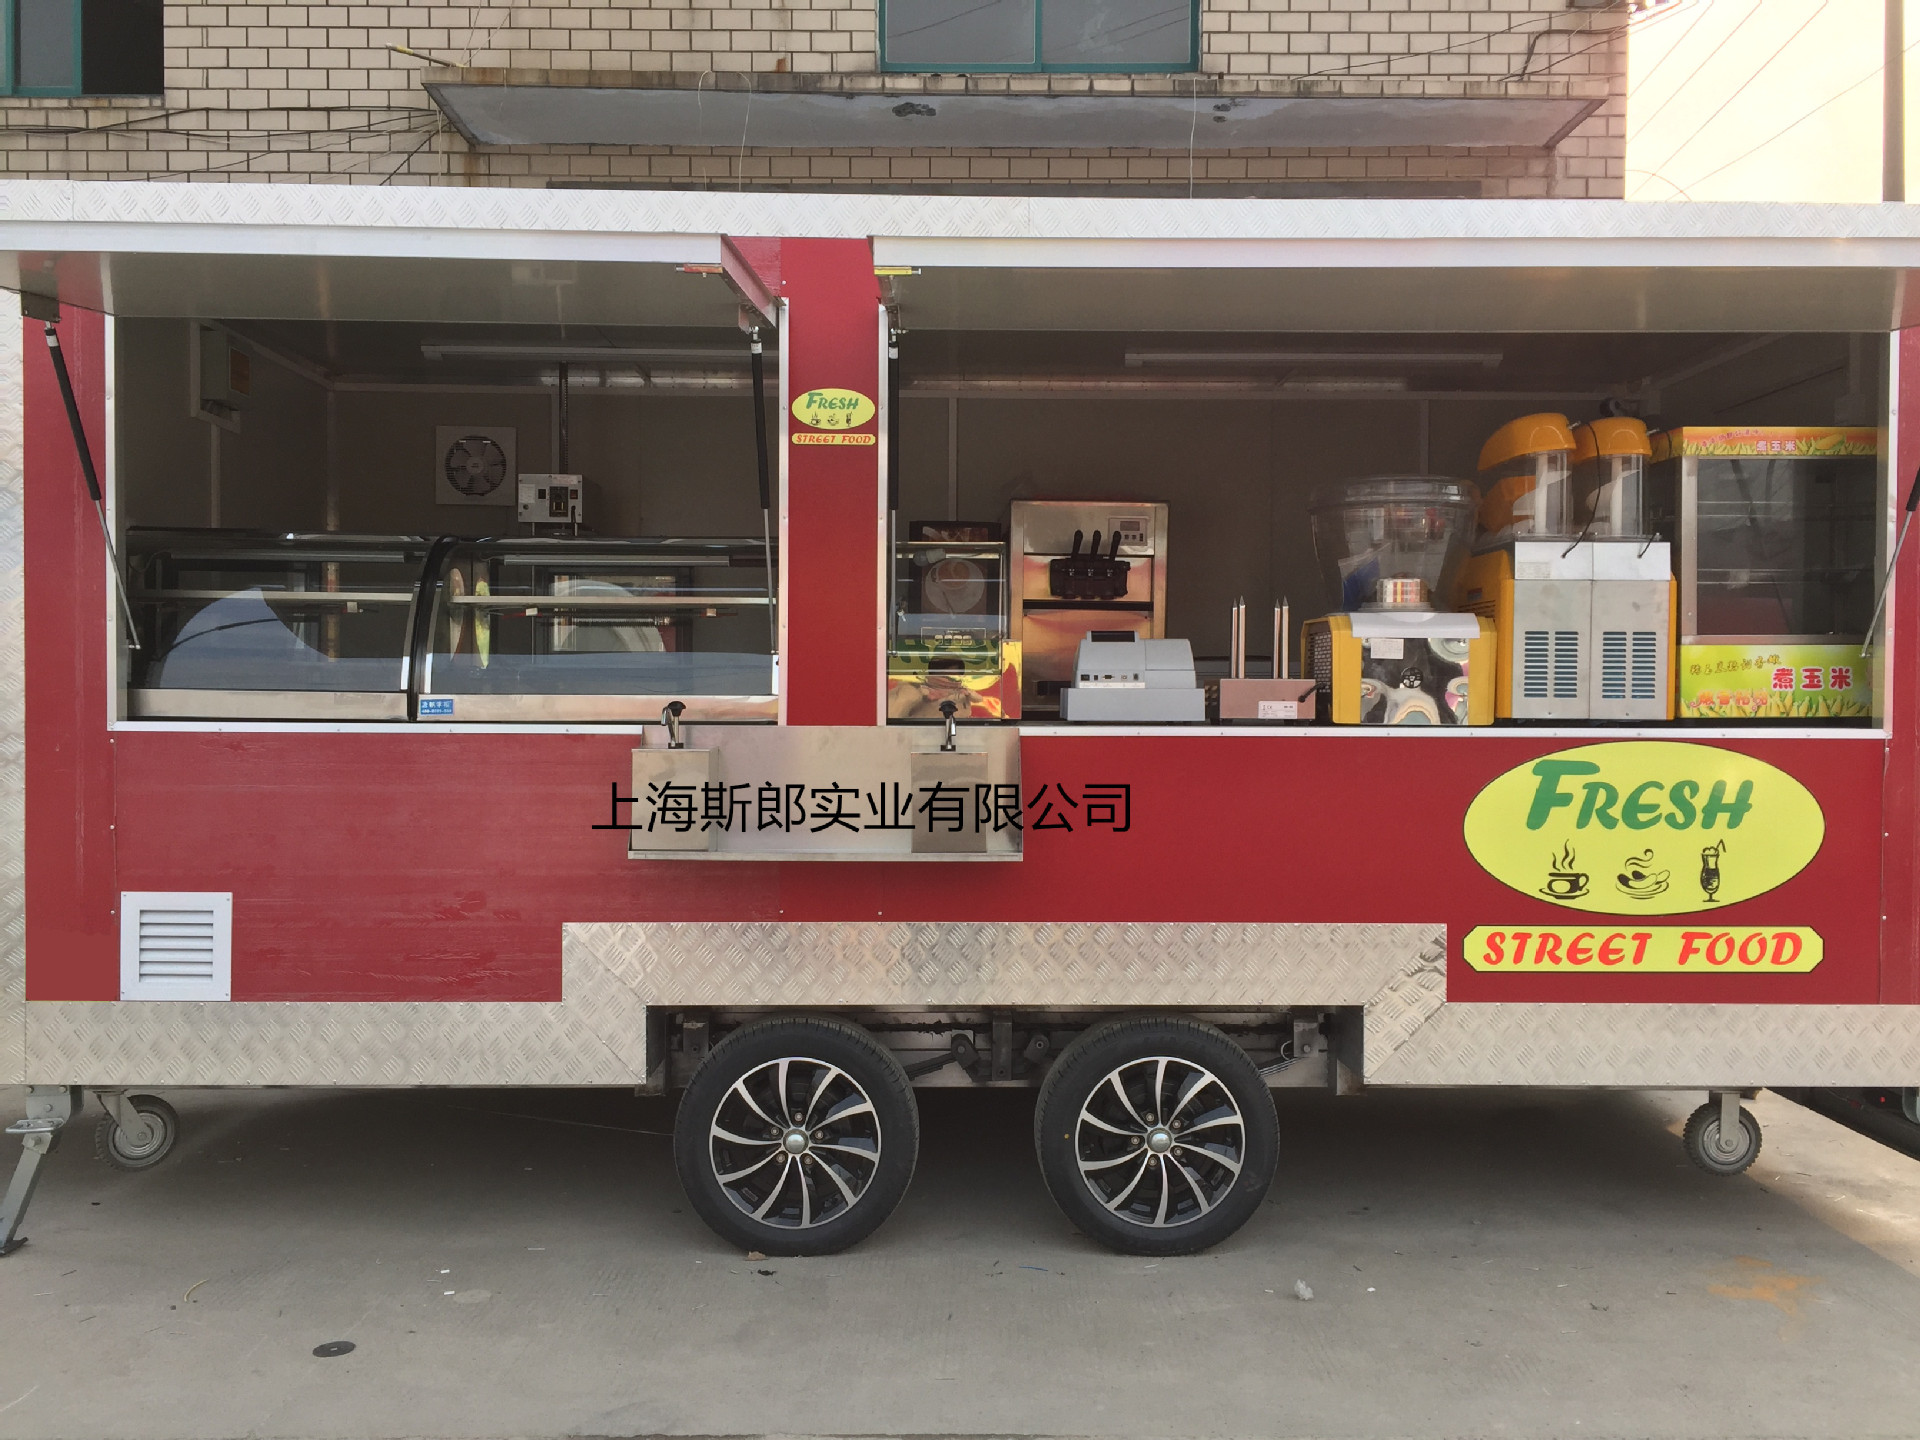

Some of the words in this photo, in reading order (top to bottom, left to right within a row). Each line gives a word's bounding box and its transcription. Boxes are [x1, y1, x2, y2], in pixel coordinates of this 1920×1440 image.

[806, 392, 859, 410] FRESH
[796, 434, 835, 443] STREET
[841, 435, 871, 443] FOOD
[1756, 440, 1797, 452] 煮玉米
[1771, 667, 1853, 692] 煮玉米
[1525, 759, 1754, 831] FRESH
[1483, 931, 1653, 966] STREET
[1678, 931, 1803, 966] FOOD
